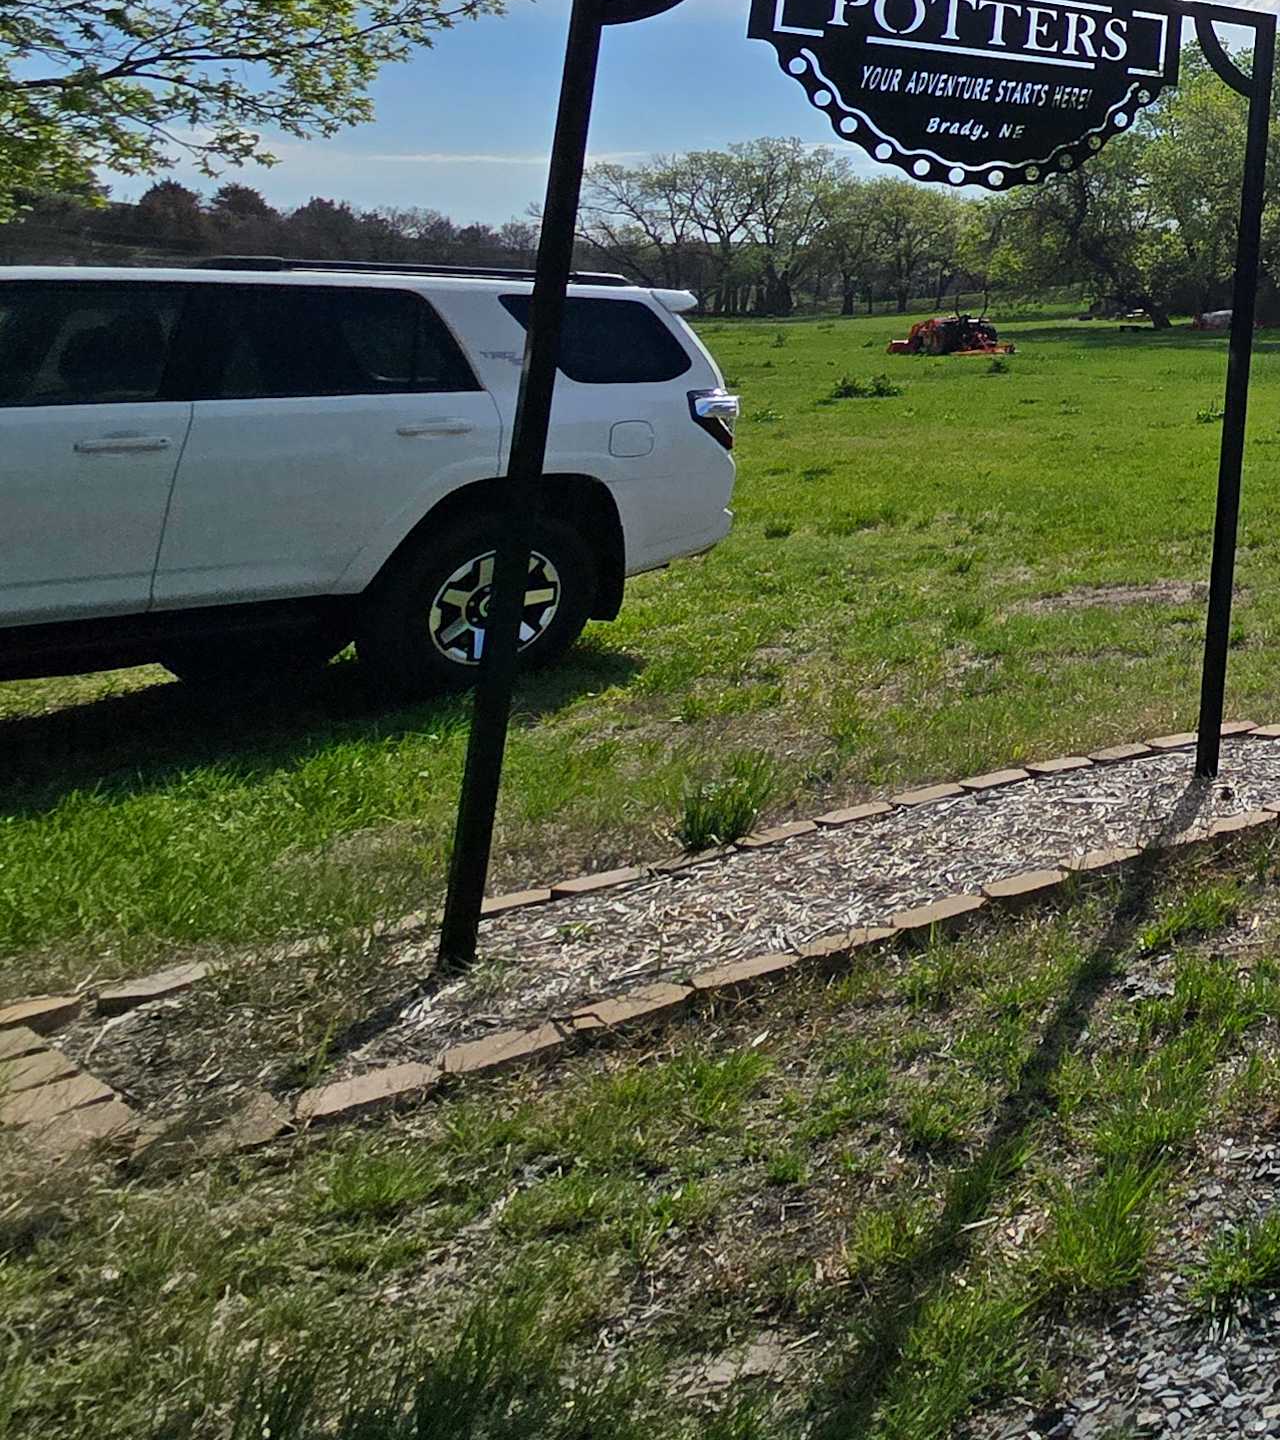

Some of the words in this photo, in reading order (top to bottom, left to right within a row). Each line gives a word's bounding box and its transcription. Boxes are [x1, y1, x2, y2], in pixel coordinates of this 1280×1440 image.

[860, 65, 903, 92] YOUR
[905, 71, 994, 102] ADVENTURE
[995, 79, 1049, 107] STARTS
[1051, 85, 1093, 110] HERE!
[925, 117, 990, 141] Brady,
[999, 123, 1025, 139] NE
